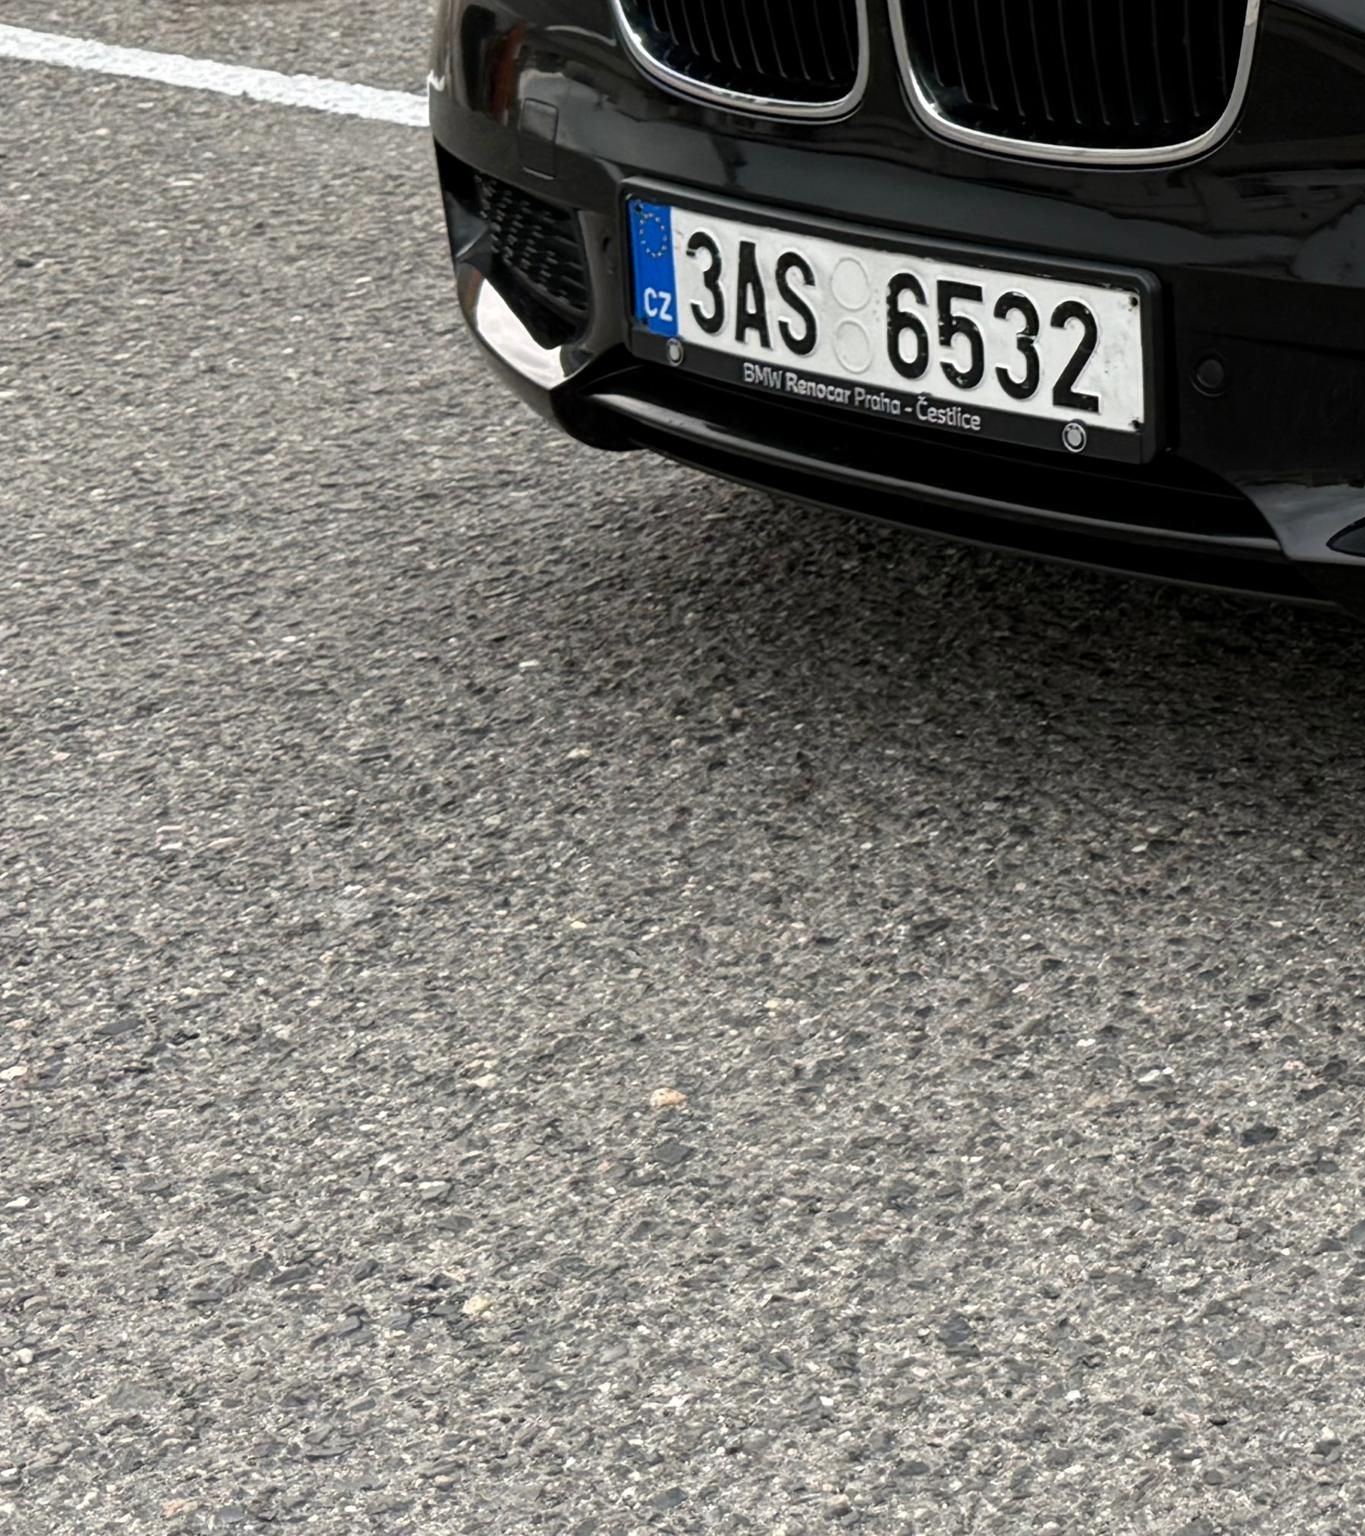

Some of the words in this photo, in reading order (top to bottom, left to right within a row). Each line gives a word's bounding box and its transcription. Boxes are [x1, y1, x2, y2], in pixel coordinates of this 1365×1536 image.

[643, 287, 672, 324] CZ
[686, 231, 817, 354] 3AS
[887, 272, 1101, 415] 6532
[743, 362, 783, 390] BMW
[786, 372, 850, 405] Renocar
[854, 389, 902, 415] Praha
[915, 396, 982, 430] Čestlice
